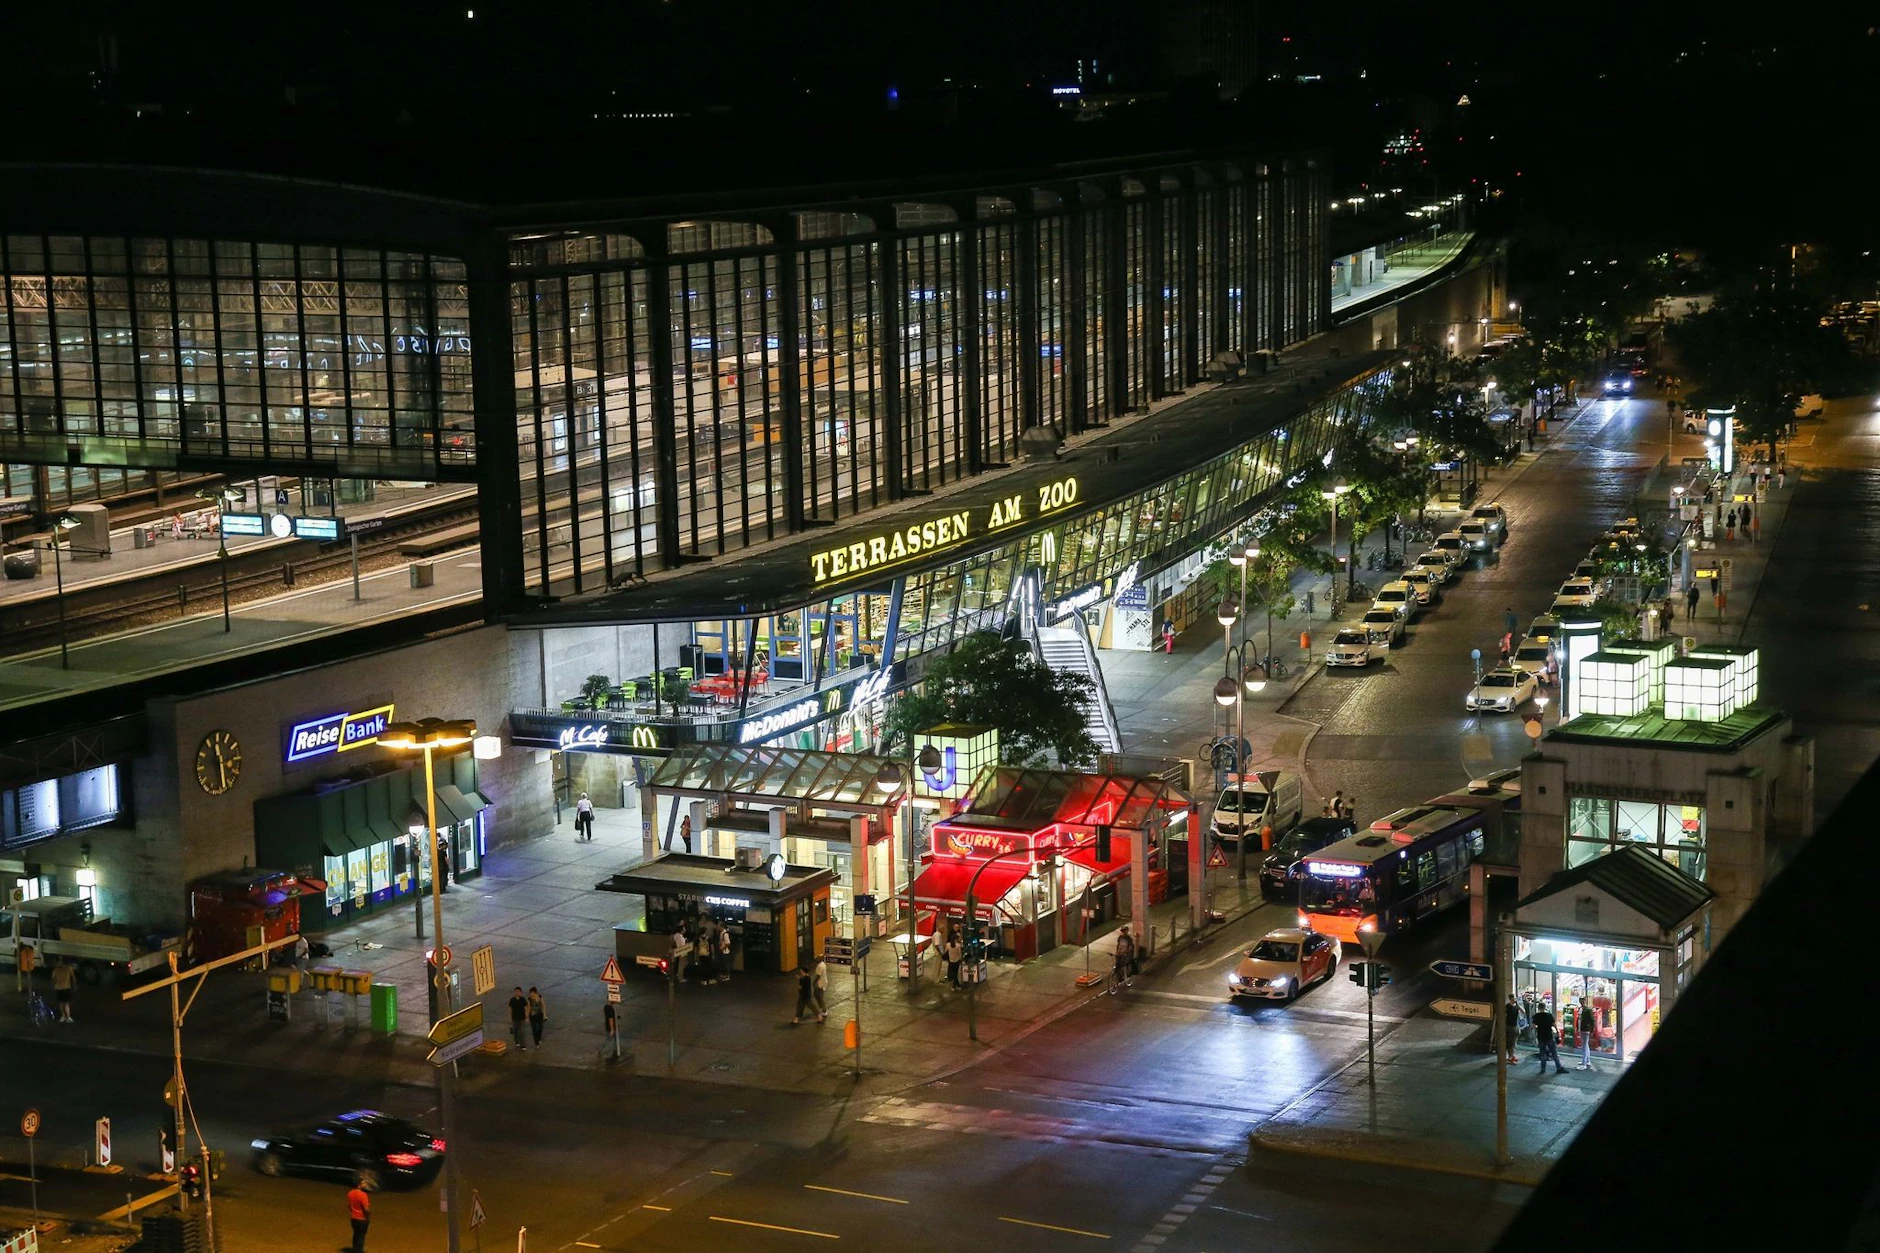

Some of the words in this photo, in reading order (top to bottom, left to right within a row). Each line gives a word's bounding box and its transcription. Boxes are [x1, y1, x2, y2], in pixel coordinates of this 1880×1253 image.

[278, 491, 286, 502] A
[811, 511, 970, 582] TERRASSEN
[988, 495, 1022, 529] AM
[1039, 477, 1077, 513] ZOO
[741, 700, 819, 744] McDonald's
[296, 725, 340, 752] Reise
[346, 715, 385, 741] Bank
[957, 832, 1000, 849] CURRY
[998, 843, 1012, 853] 36
[327, 852, 388, 887] CHANGE
[677, 893, 721, 905] STARBUCKS
[721, 897, 750, 908] COFFEE
[1461, 1005, 1480, 1014] Tegel
[25, 1115, 36, 1130] 30
